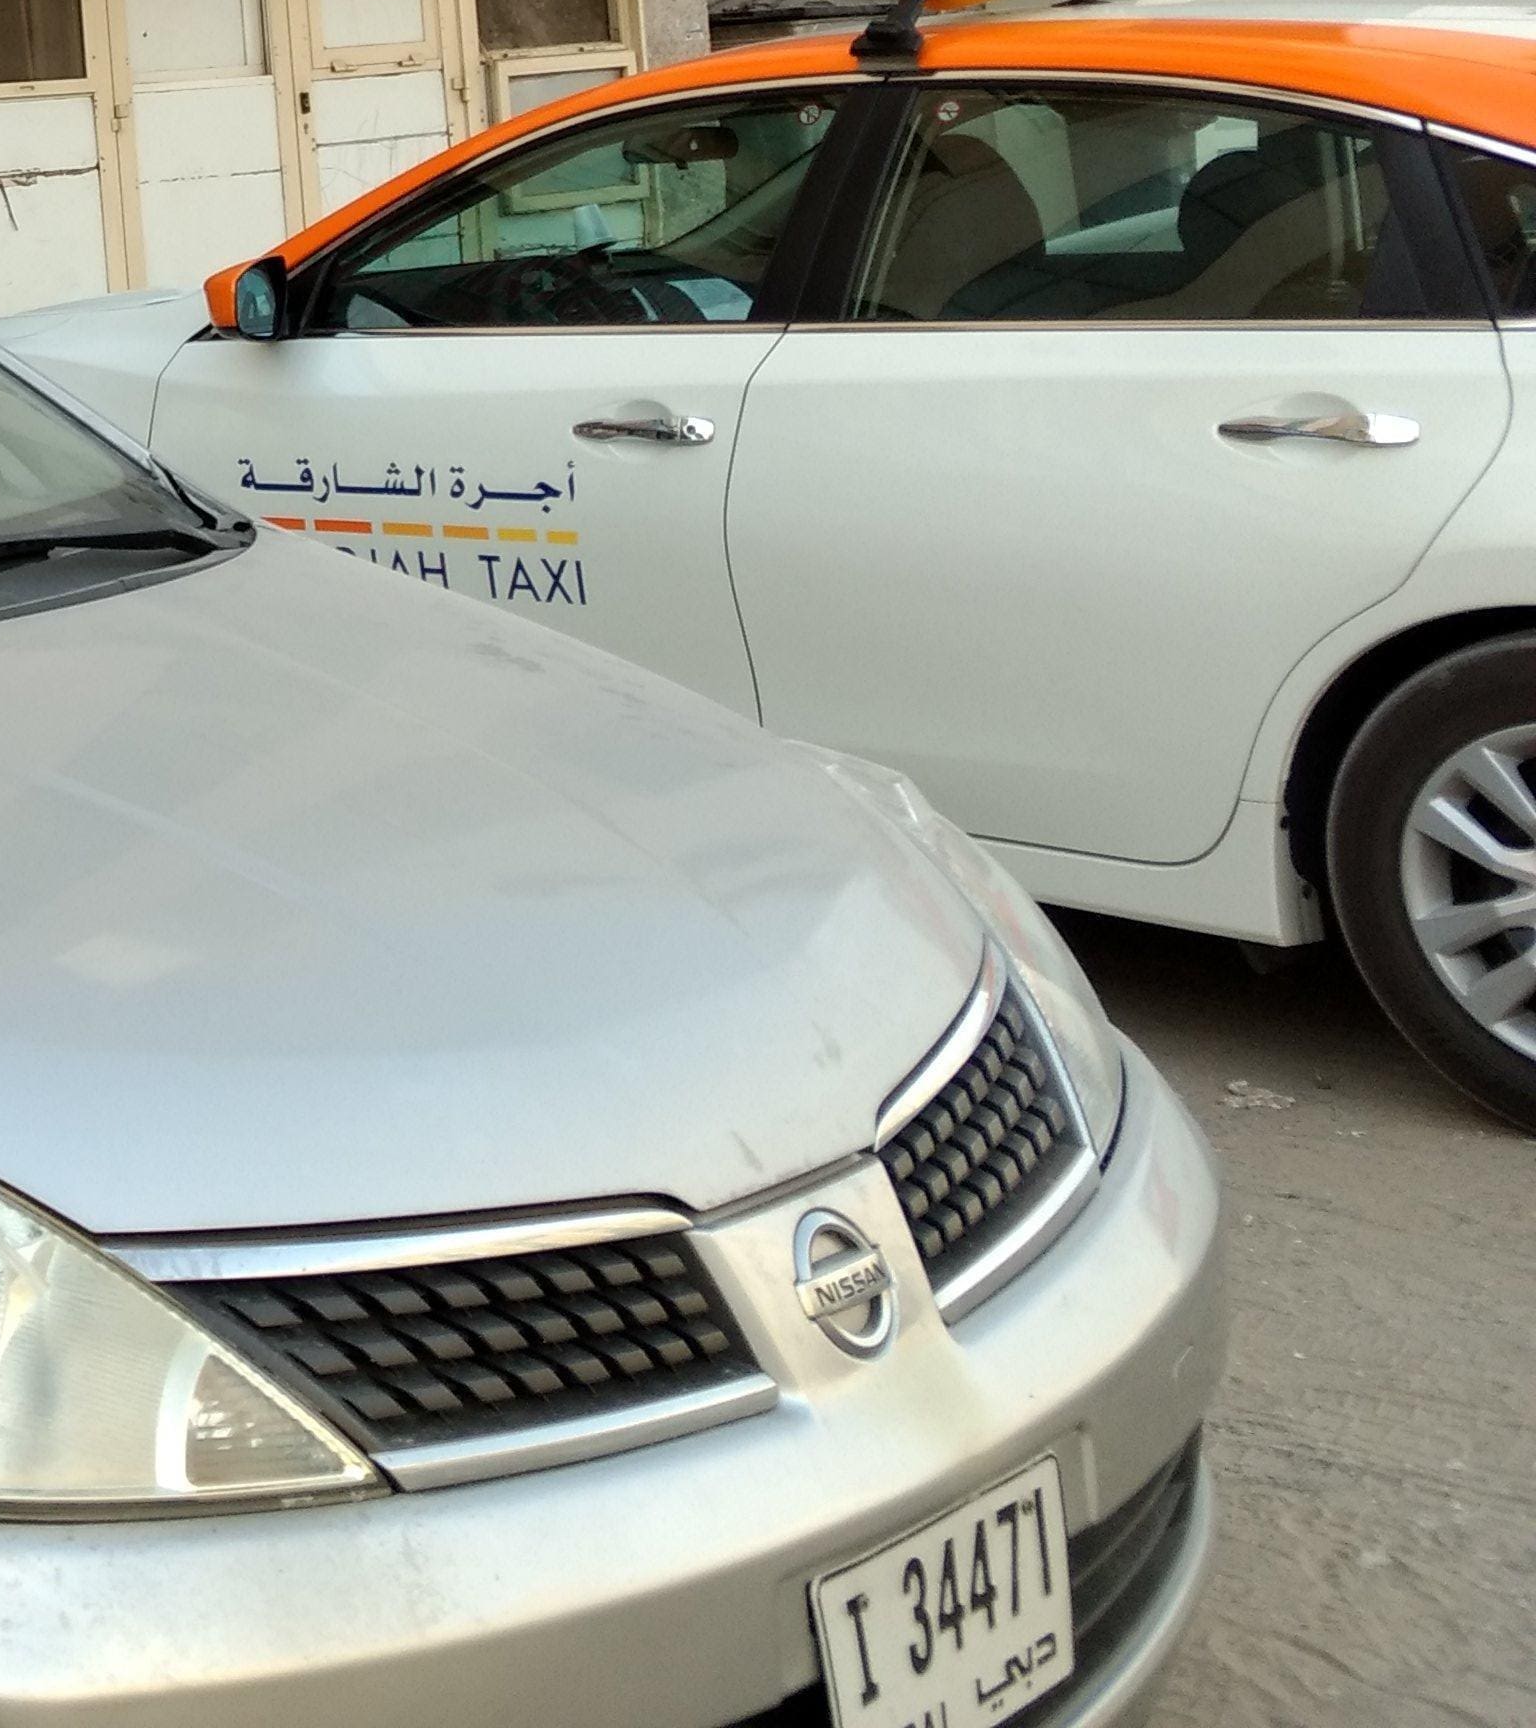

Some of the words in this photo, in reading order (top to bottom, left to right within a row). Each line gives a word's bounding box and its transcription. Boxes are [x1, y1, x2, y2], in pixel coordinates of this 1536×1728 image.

[237, 458, 436, 504] الشارقة
[449, 459, 576, 514] أجرة
[478, 554, 587, 605] TAXI
[814, 1260, 887, 1308] NISSAN
[902, 1486, 1054, 1675] 34471
[975, 1631, 1058, 1712] دبي
